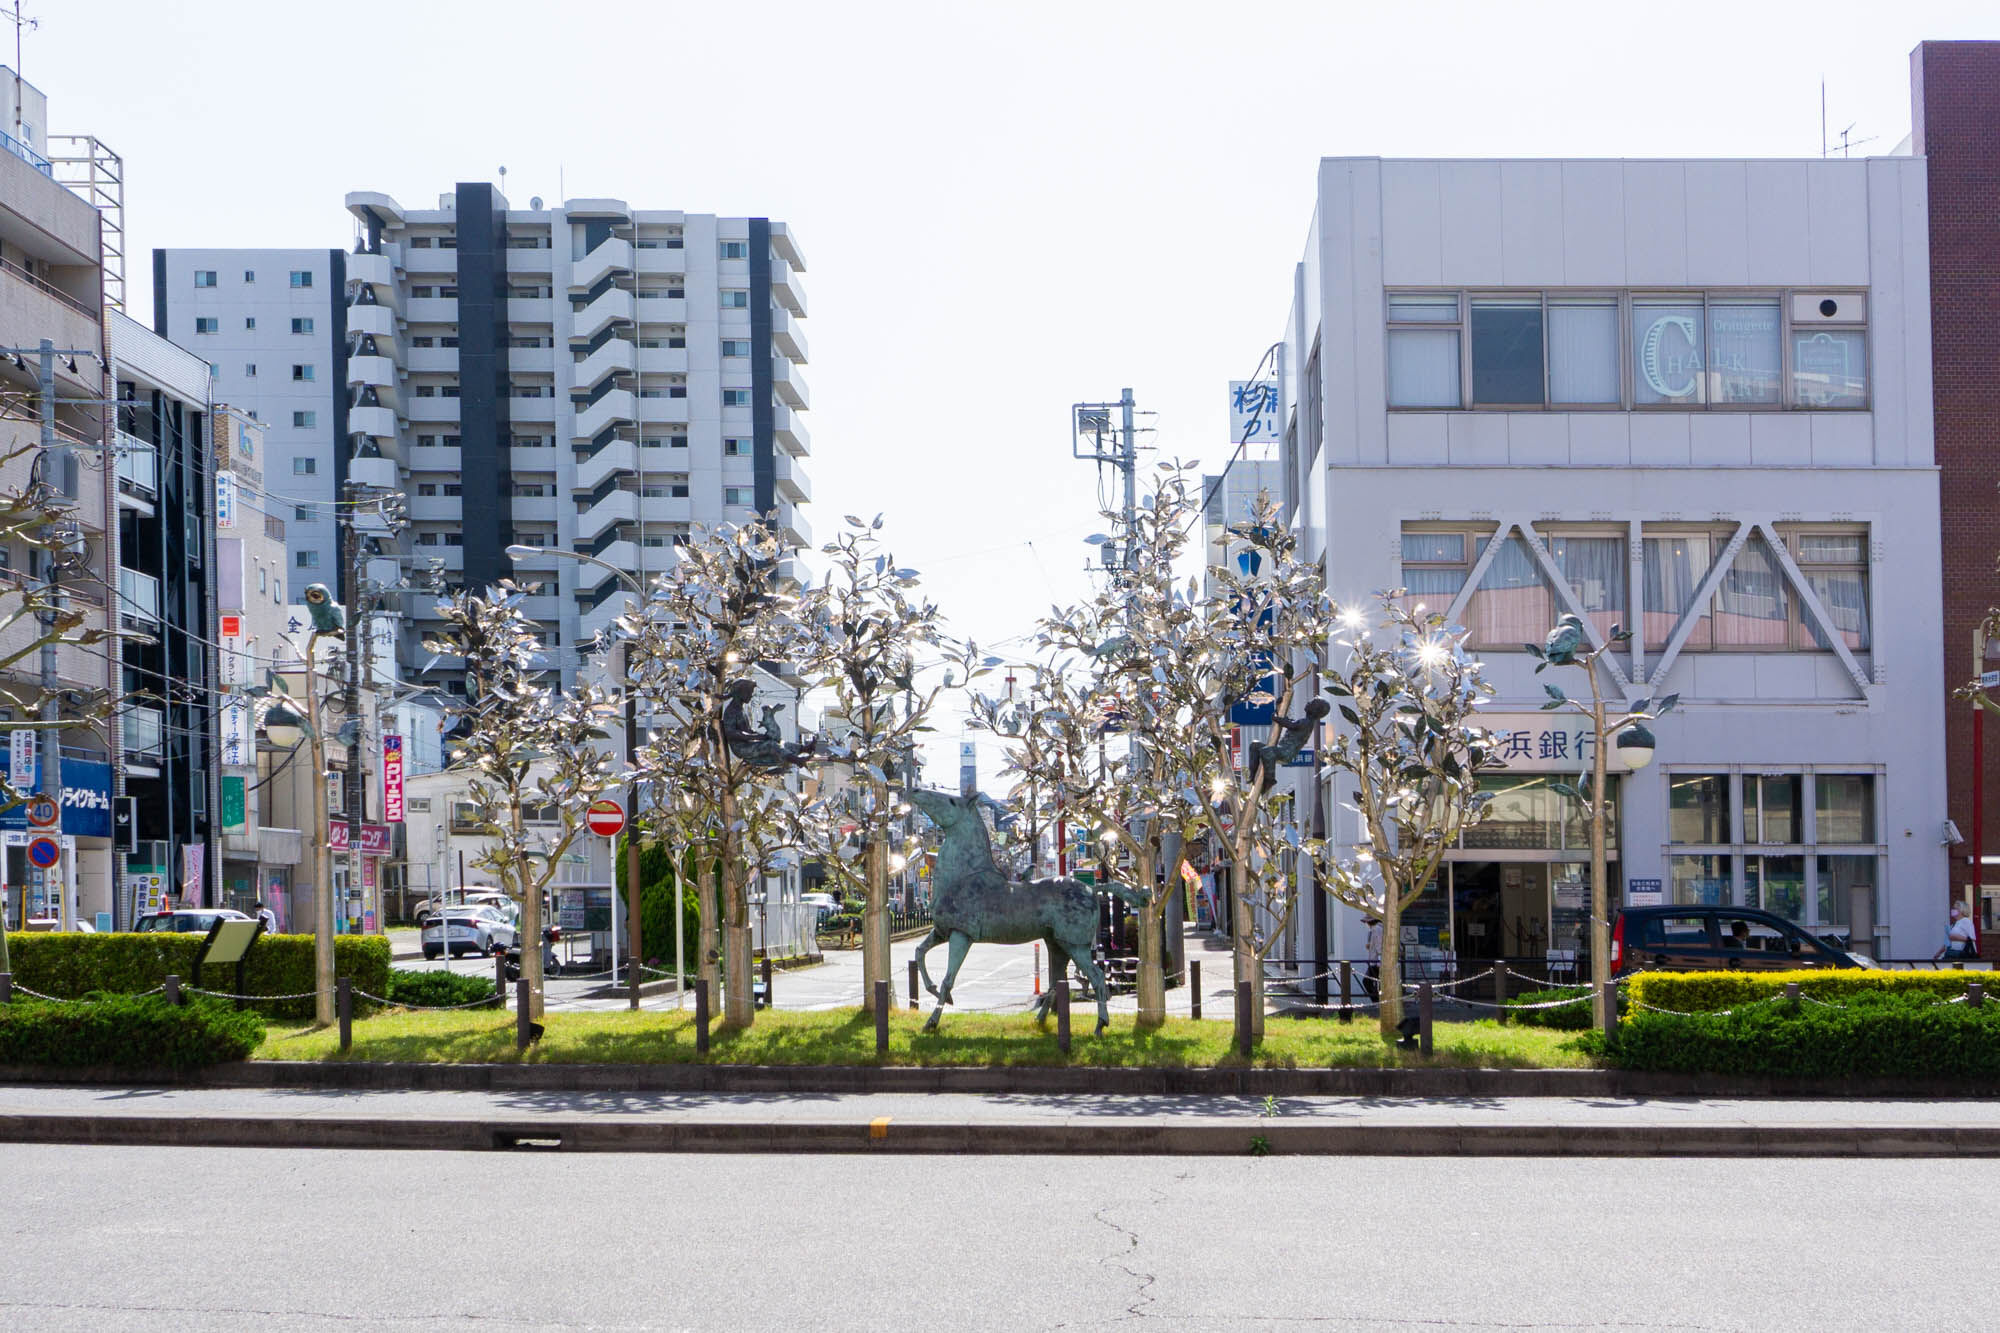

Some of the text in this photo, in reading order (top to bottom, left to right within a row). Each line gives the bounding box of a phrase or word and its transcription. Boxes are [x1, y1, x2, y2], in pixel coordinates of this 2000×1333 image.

[1489, 730, 1595, 760] 浜銀行
[386, 763, 400, 820] クリーニング
[34, 804, 53, 818] 40
